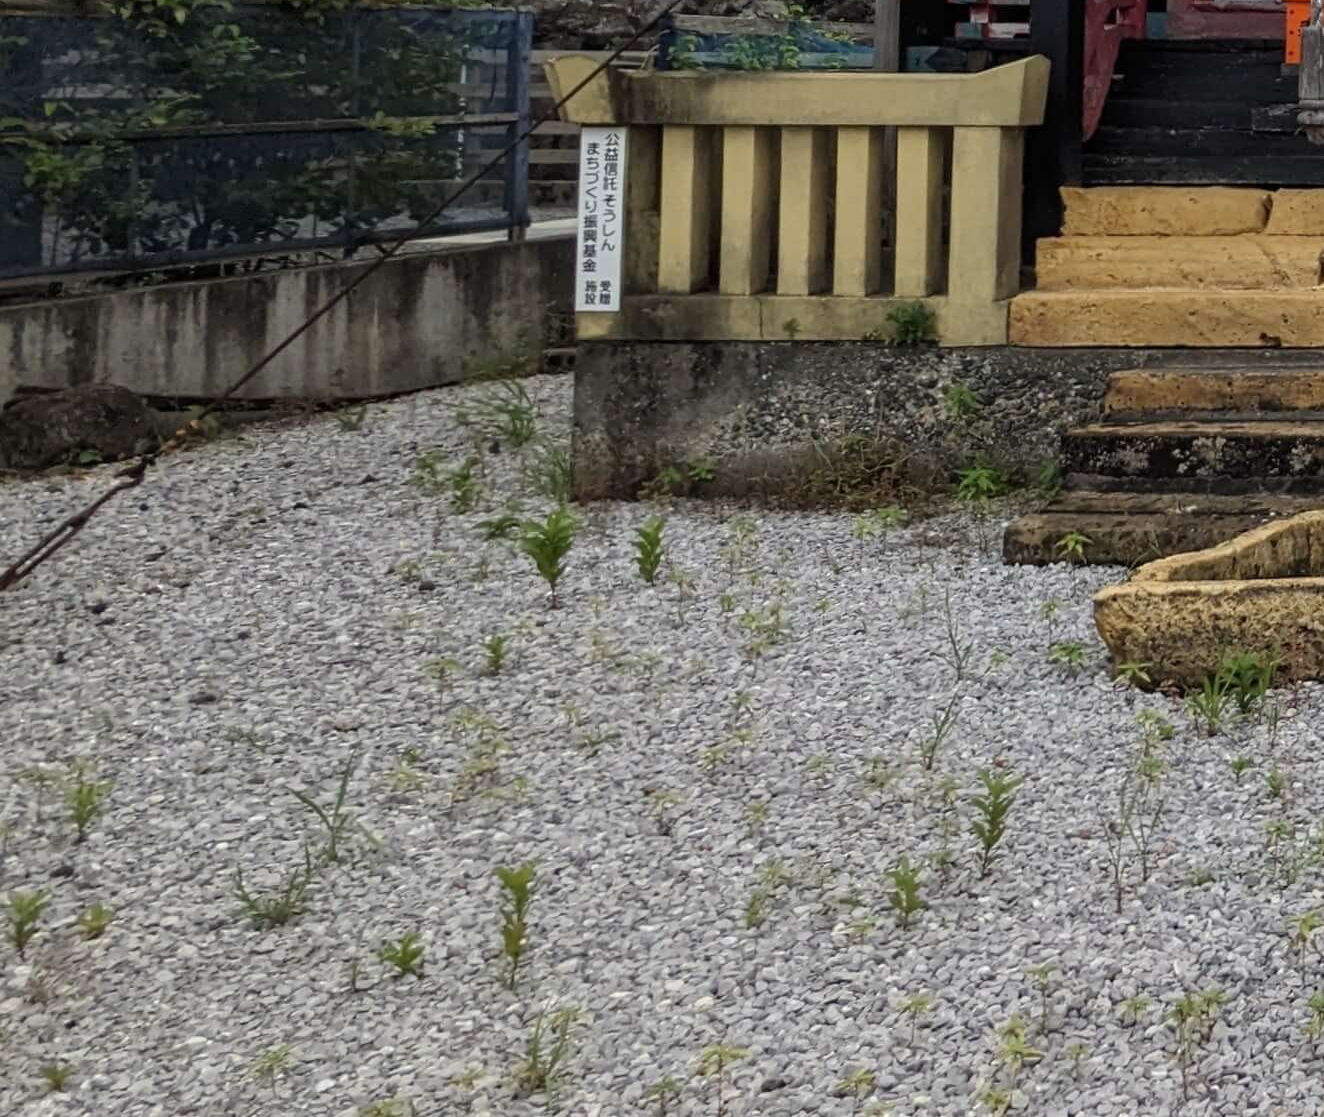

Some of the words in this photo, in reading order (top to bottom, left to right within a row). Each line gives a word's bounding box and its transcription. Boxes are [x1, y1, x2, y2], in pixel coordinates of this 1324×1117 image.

[582, 142, 600, 273] まちづくり振興基金
[584, 280, 597, 305] 施設
